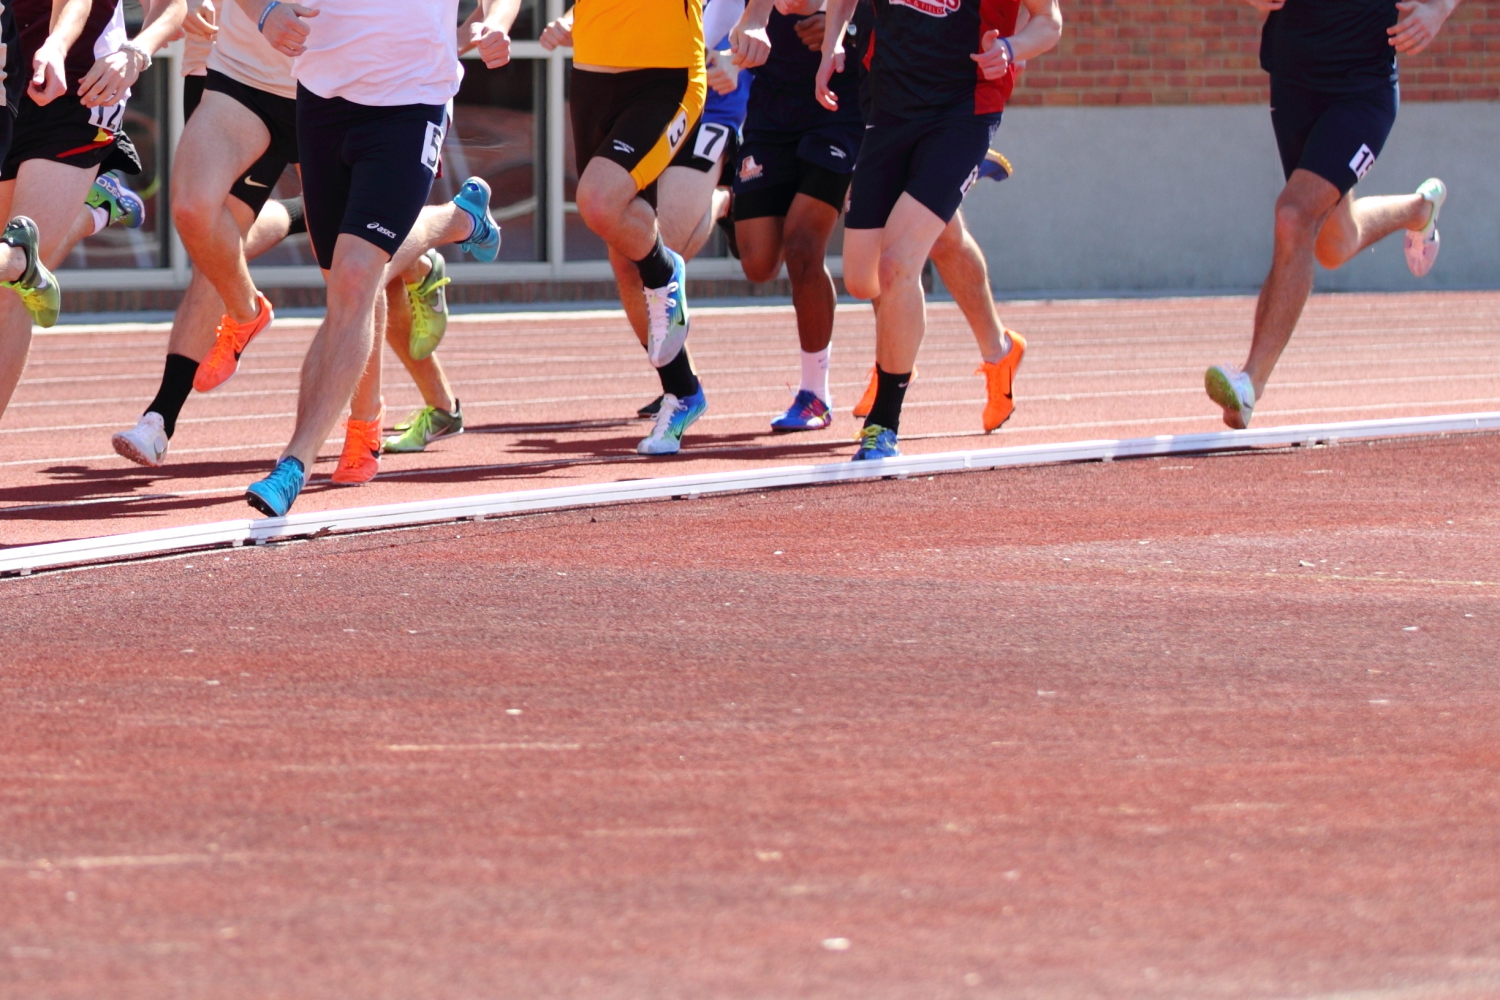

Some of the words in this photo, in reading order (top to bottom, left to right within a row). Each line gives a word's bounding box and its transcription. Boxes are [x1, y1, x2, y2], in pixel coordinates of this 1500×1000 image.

[426, 126, 442, 168] 5
[703, 125, 725, 157] 7
[376, 226, 397, 239] asics
